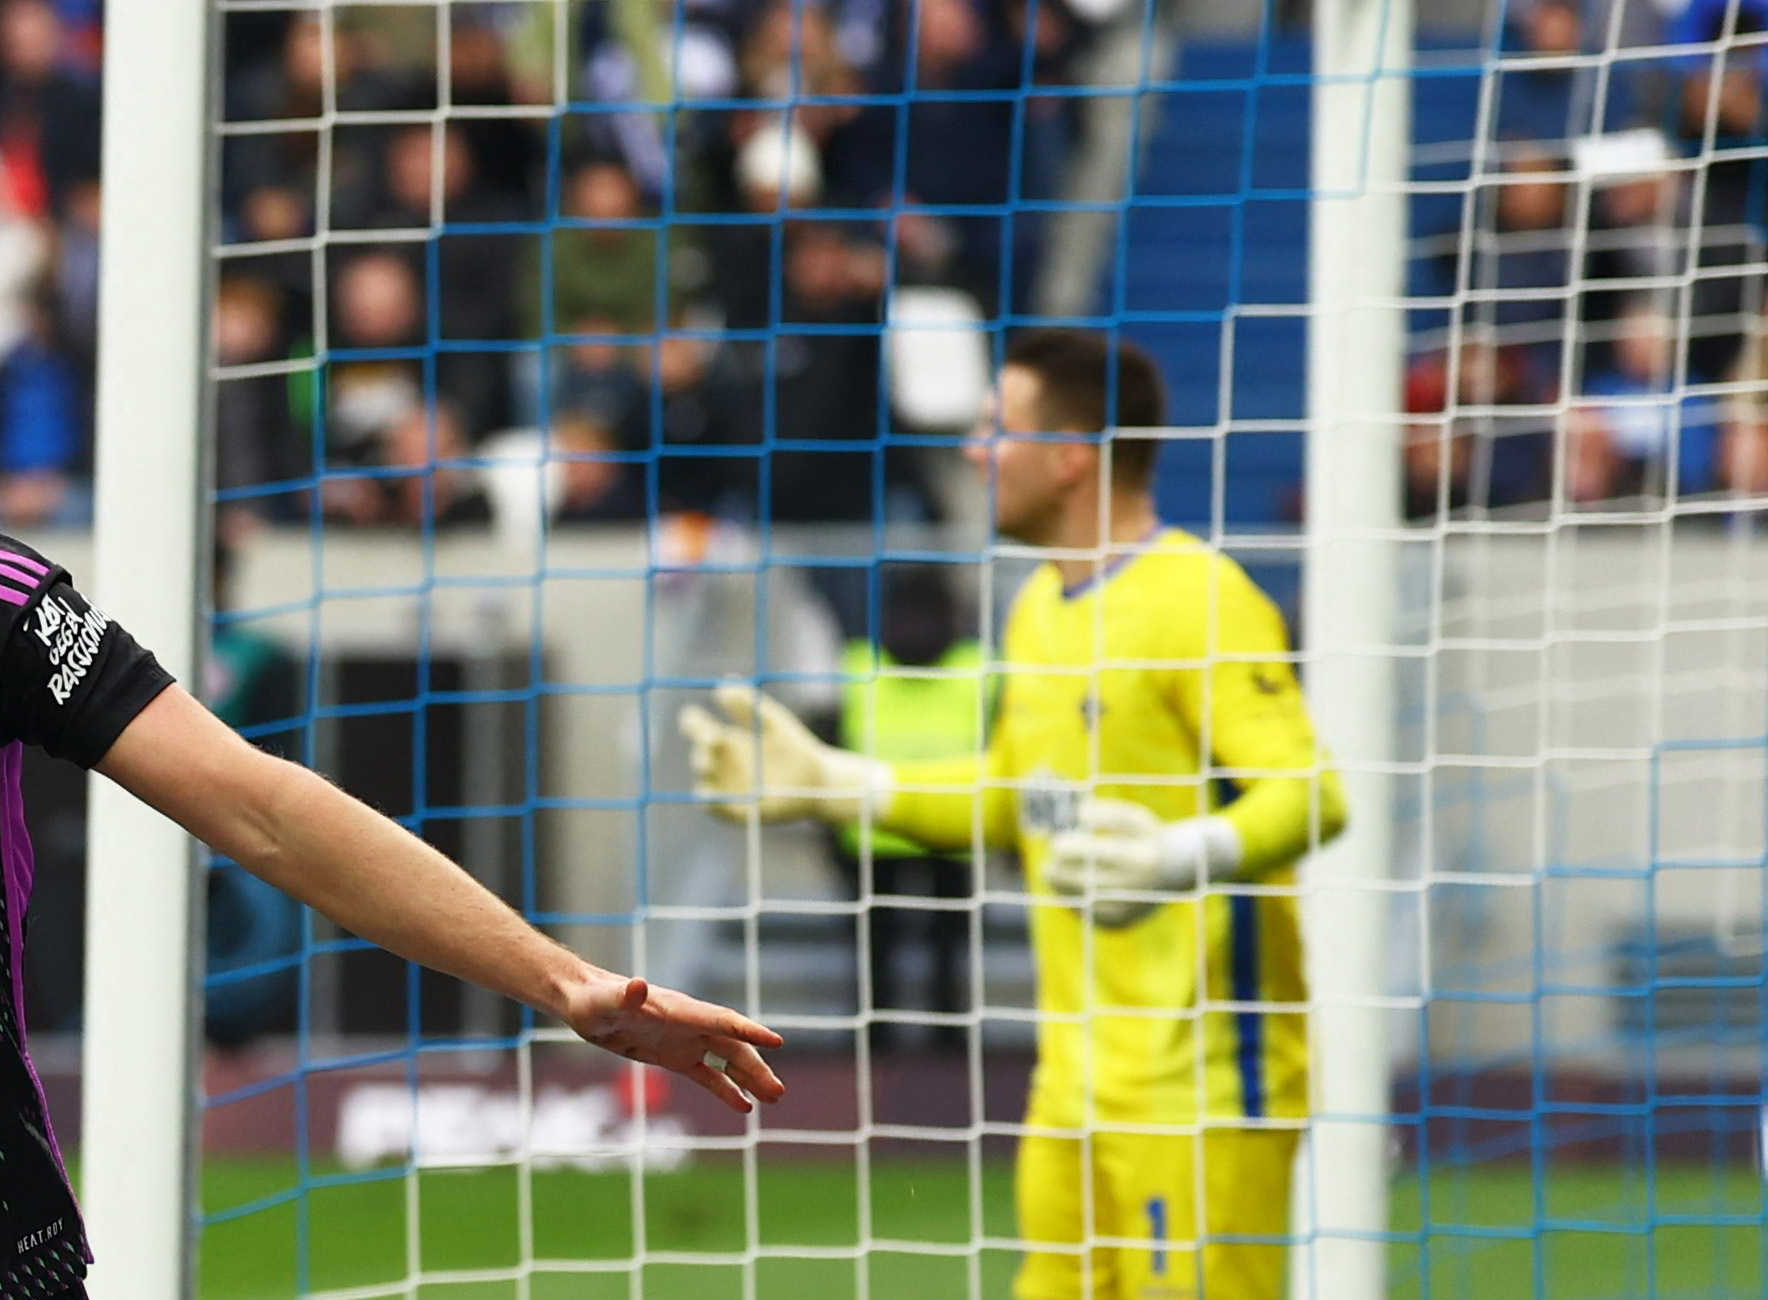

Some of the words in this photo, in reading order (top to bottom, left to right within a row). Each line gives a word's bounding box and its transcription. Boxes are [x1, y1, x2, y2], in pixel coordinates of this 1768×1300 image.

[47, 597, 112, 706] RASSISMU
[16, 1216, 64, 1255] HEAT.RDY
[1146, 1197, 1167, 1275] 1
